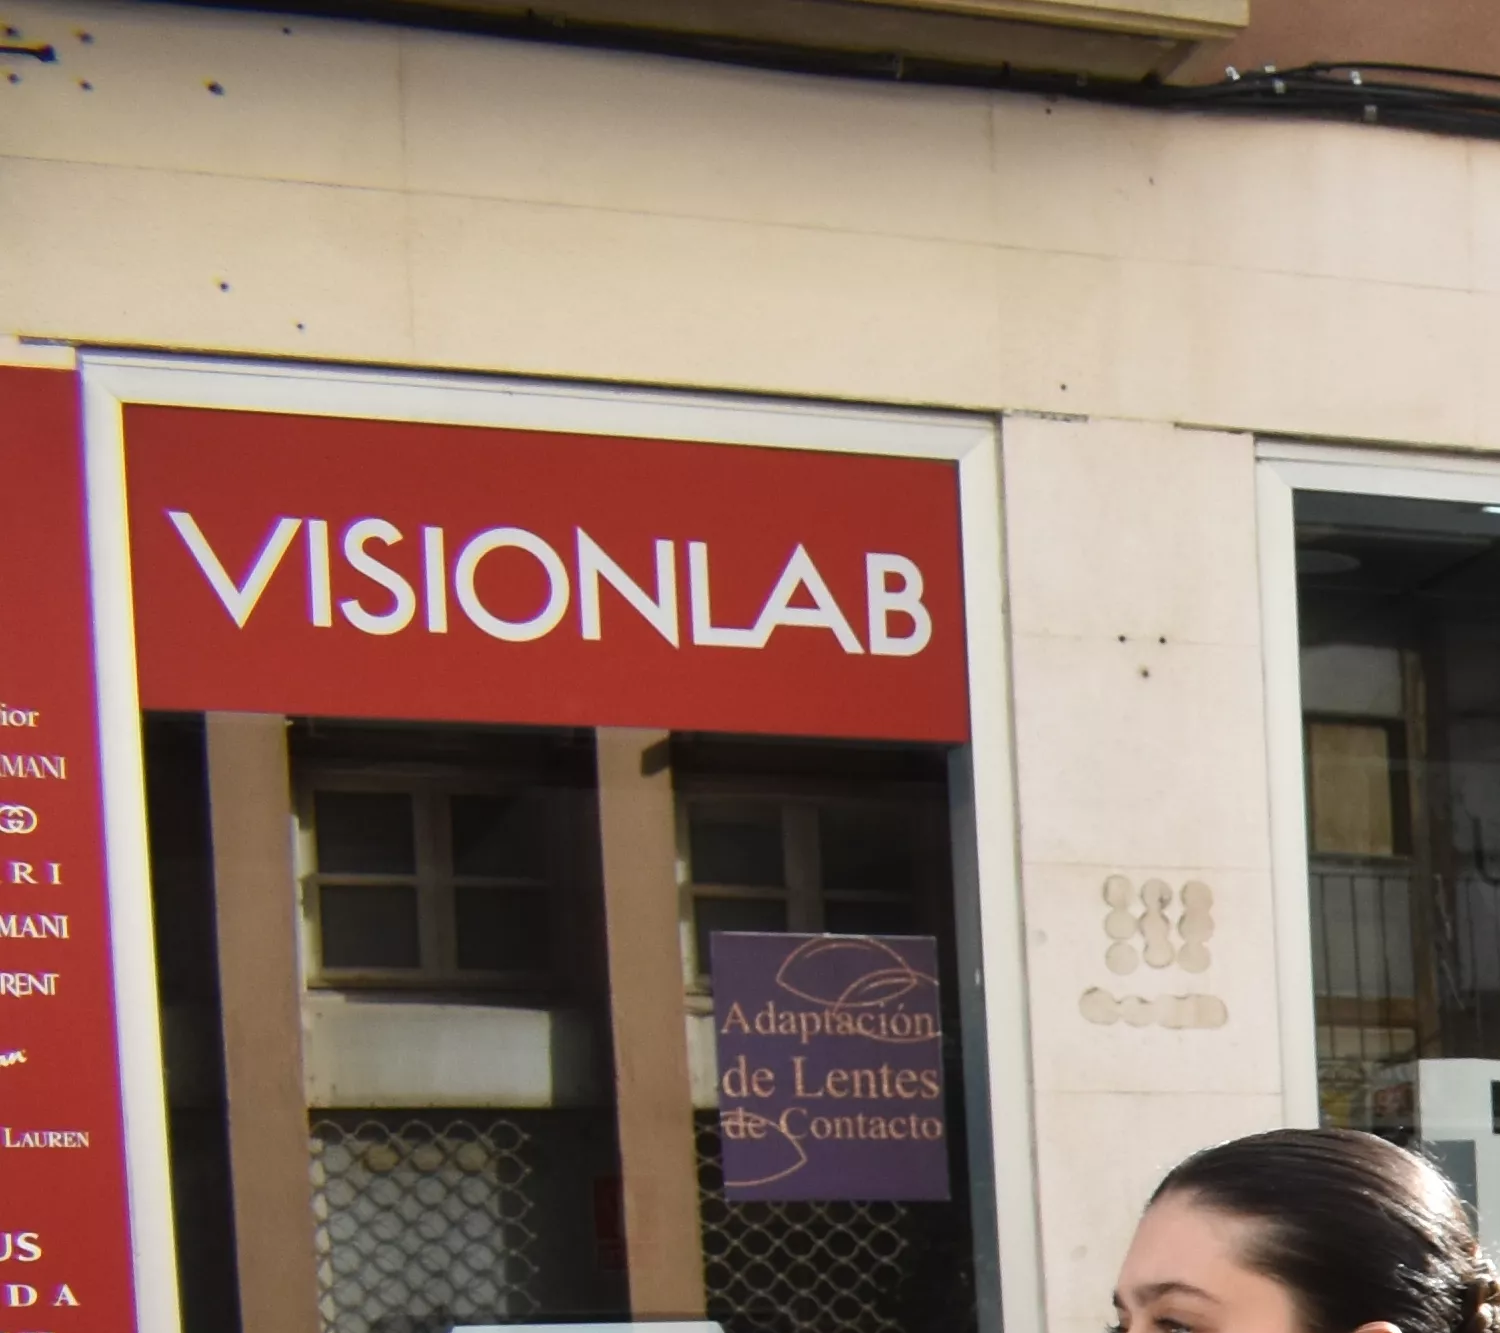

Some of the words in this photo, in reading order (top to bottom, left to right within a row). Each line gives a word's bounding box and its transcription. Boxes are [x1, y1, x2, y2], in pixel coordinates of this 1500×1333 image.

[167, 510, 933, 657] VISIONLAB
[0, 756, 67, 780] MANI
[721, 1000, 935, 1044] Adaptación
[722, 1054, 775, 1098] de
[792, 1055, 940, 1099] Lentes
[723, 1106, 767, 1139] de
[779, 1107, 943, 1139] Contacto
